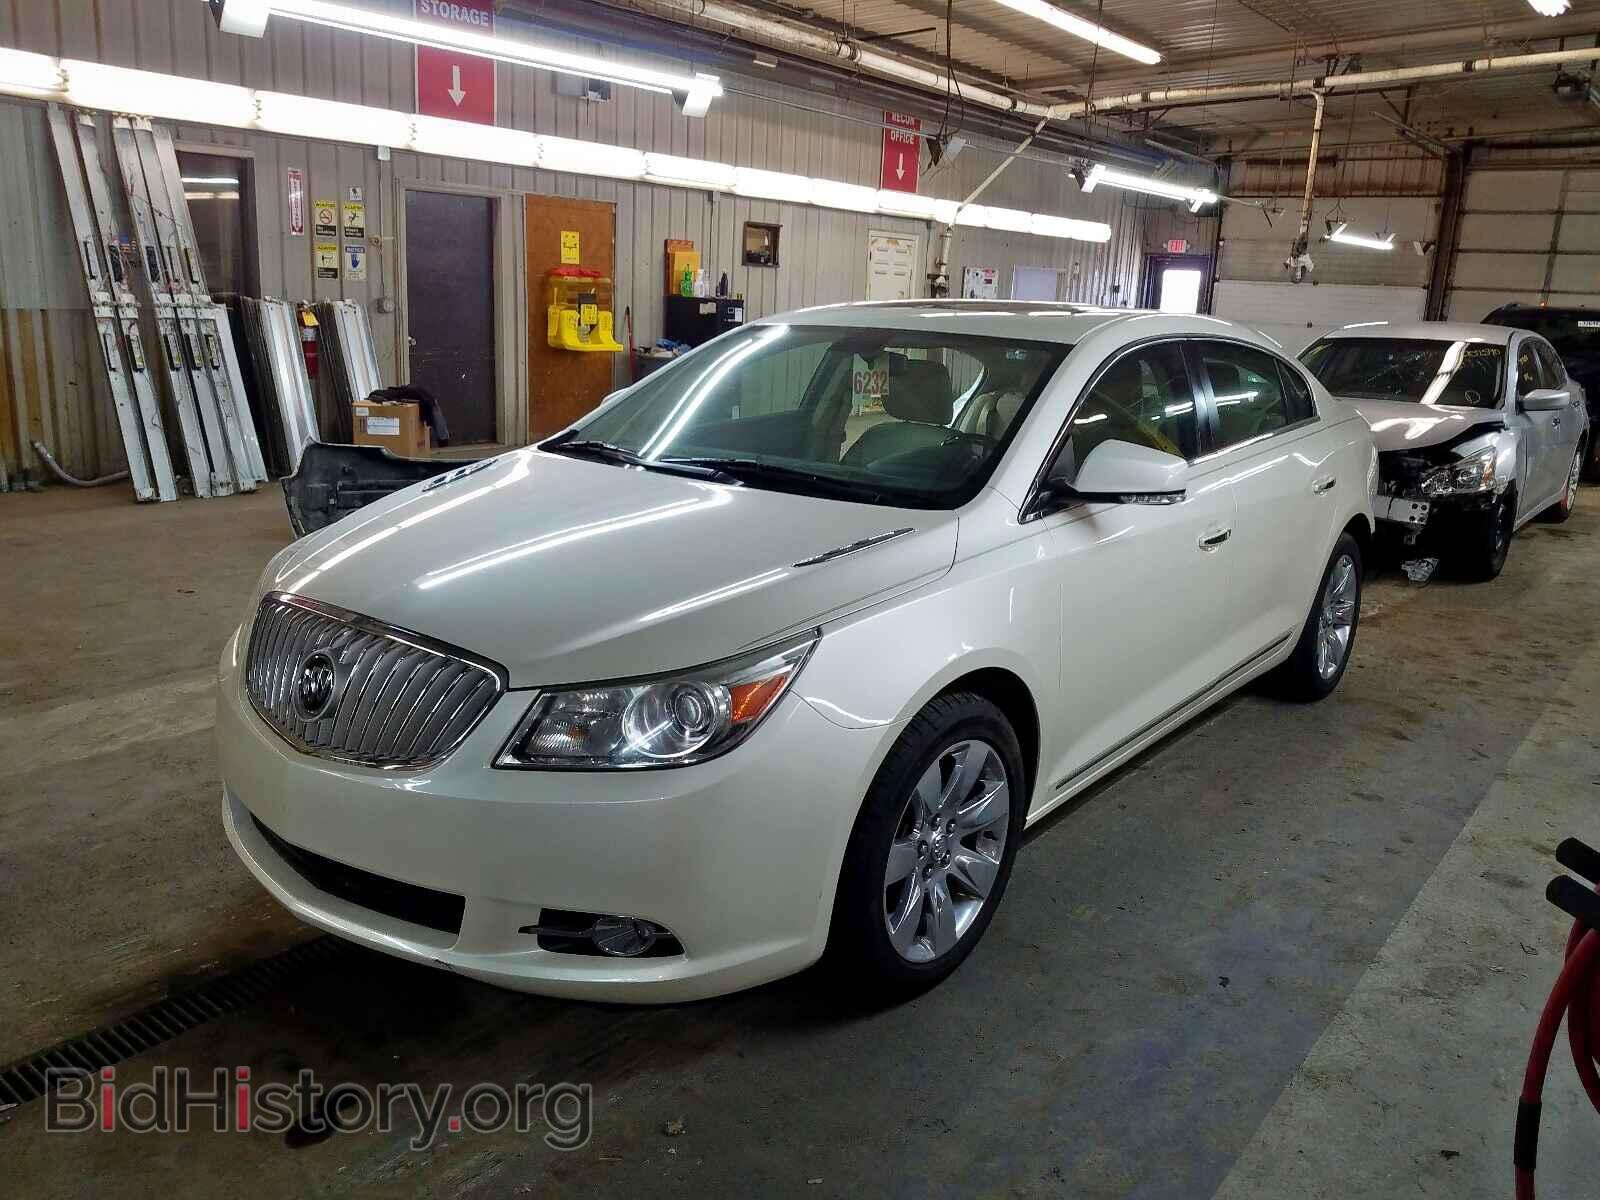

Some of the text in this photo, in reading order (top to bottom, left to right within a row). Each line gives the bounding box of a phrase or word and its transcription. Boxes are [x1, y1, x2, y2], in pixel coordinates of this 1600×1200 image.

[420, 0, 489, 26] STORAGE
[891, 111, 915, 125] RECON
[890, 128, 915, 145] OFFICE
[854, 371, 888, 394] 6232
